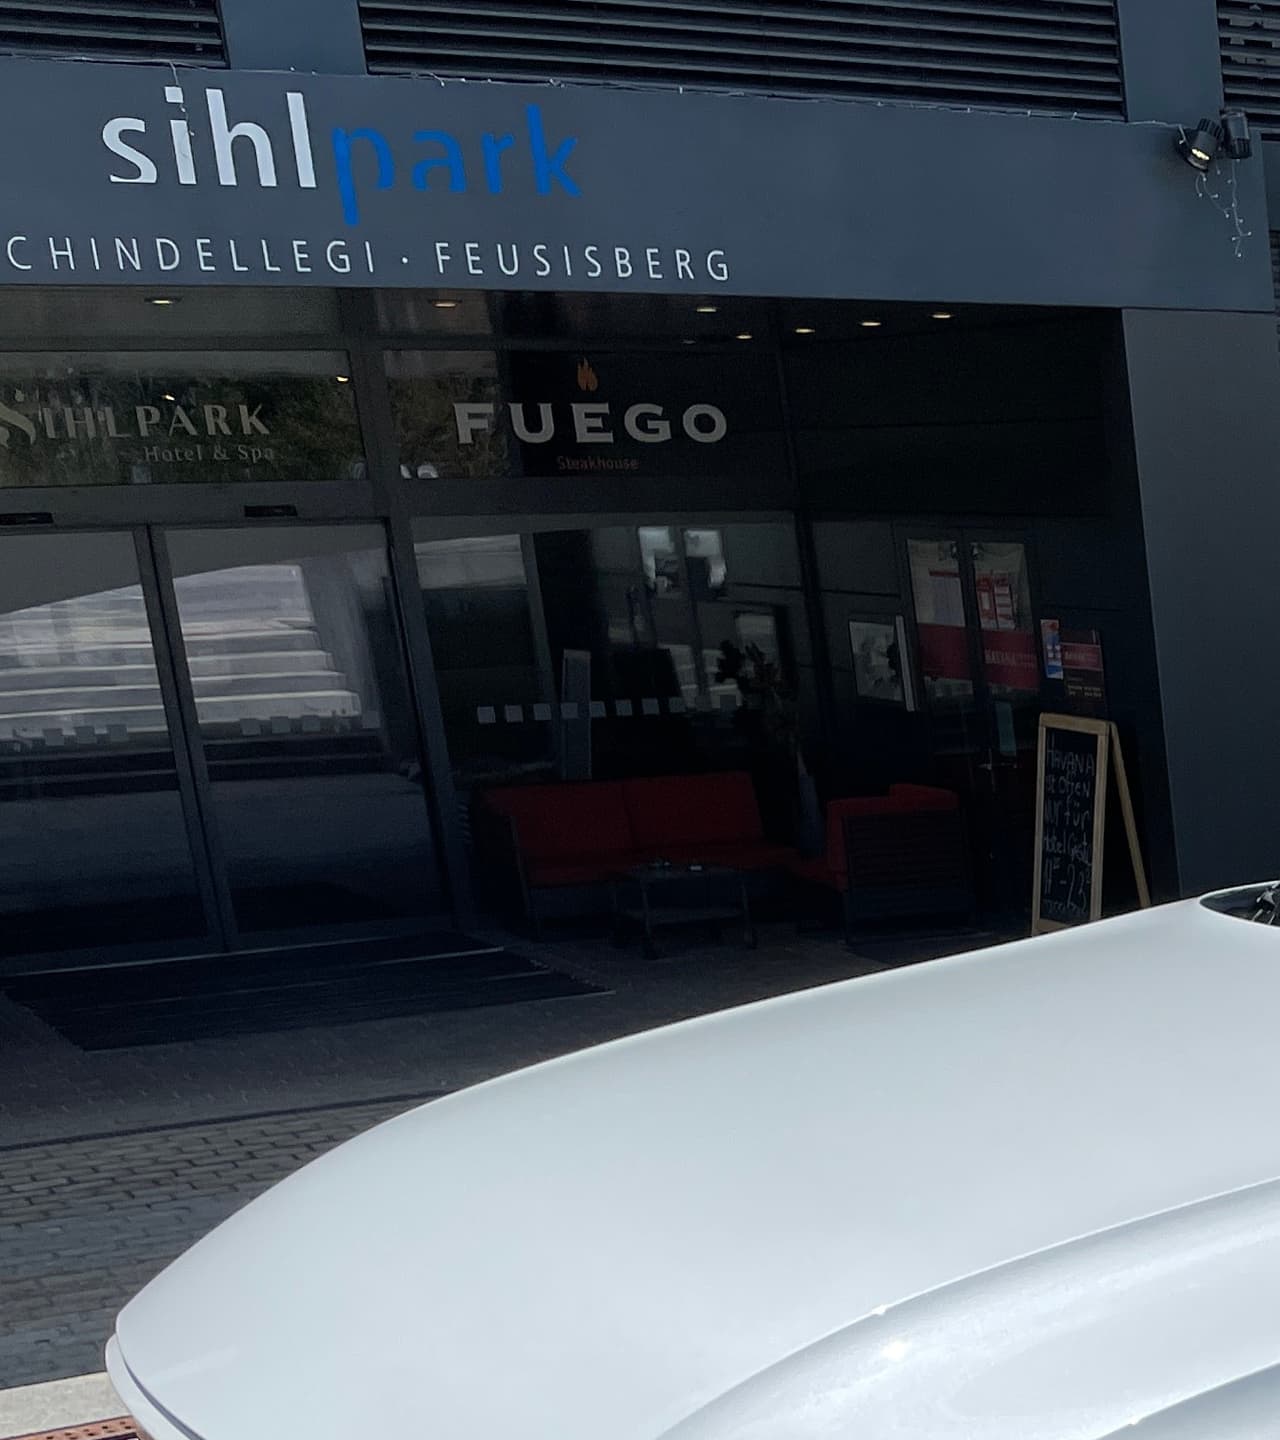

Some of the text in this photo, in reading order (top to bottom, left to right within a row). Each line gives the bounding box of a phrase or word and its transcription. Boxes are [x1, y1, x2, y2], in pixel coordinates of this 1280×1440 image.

[101, 86, 583, 227] sihlpark
[434, 242, 730, 281] FEUSISBERG
[452, 402, 728, 445] FUEGO
[144, 445, 275, 465] Hotel & Spa
